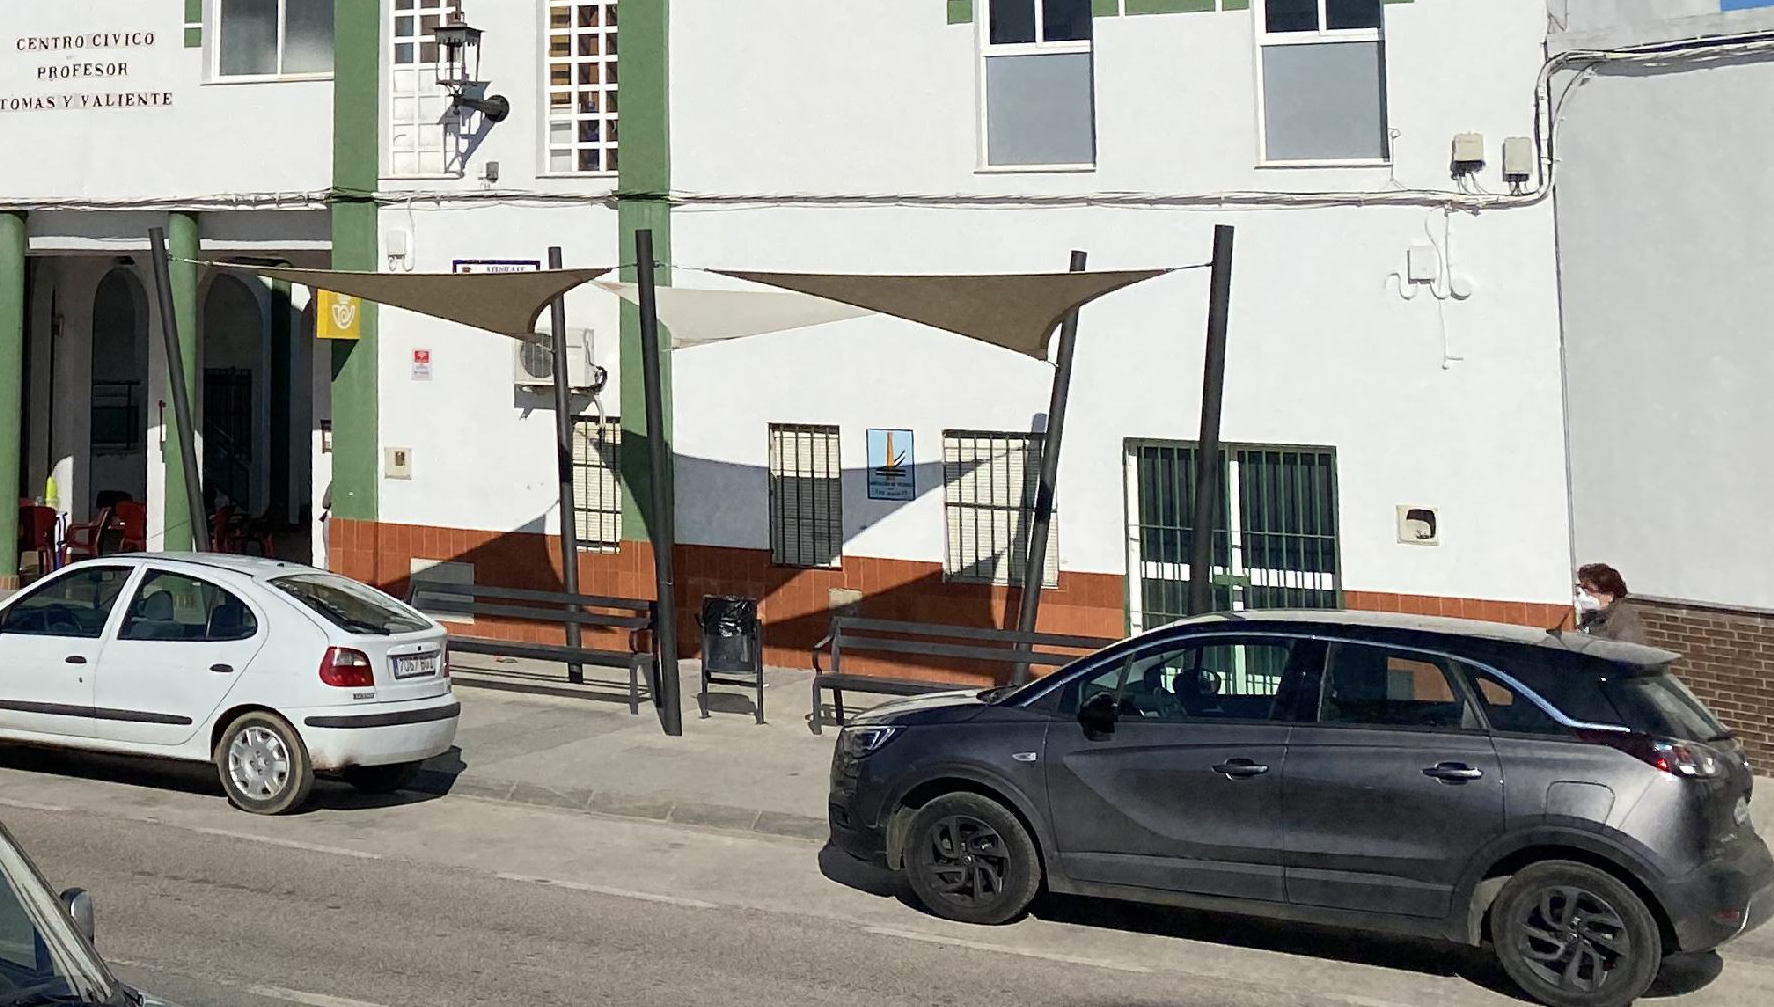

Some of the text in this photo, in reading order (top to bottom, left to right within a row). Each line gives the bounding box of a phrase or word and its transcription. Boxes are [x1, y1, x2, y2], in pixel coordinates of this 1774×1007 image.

[16, 32, 155, 51] CENTRO CIVICO
[37, 62, 128, 79] PROFESOR
[0, 92, 173, 111] TOMAS Y VALIENTE
